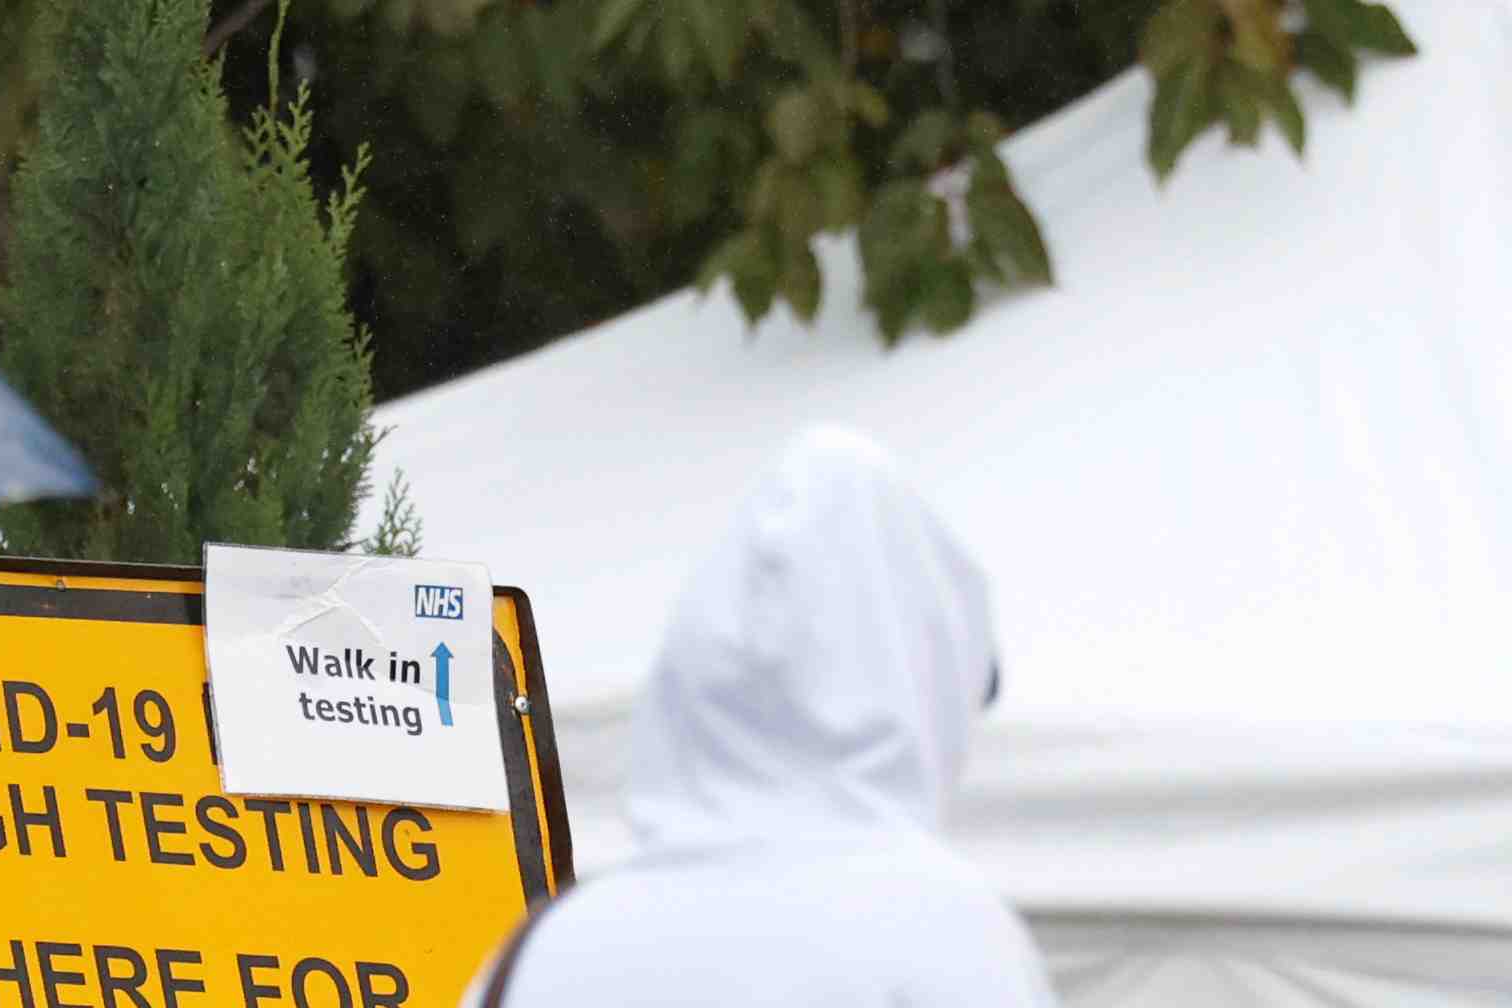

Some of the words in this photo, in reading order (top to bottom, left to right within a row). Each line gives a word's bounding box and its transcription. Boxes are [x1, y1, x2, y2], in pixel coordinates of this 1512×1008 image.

[416, 587, 463, 618] NHS
[287, 646, 375, 681] Walk
[389, 651, 421, 685] in
[298, 692, 424, 736] testing
[85, 788, 442, 881] TESTING
